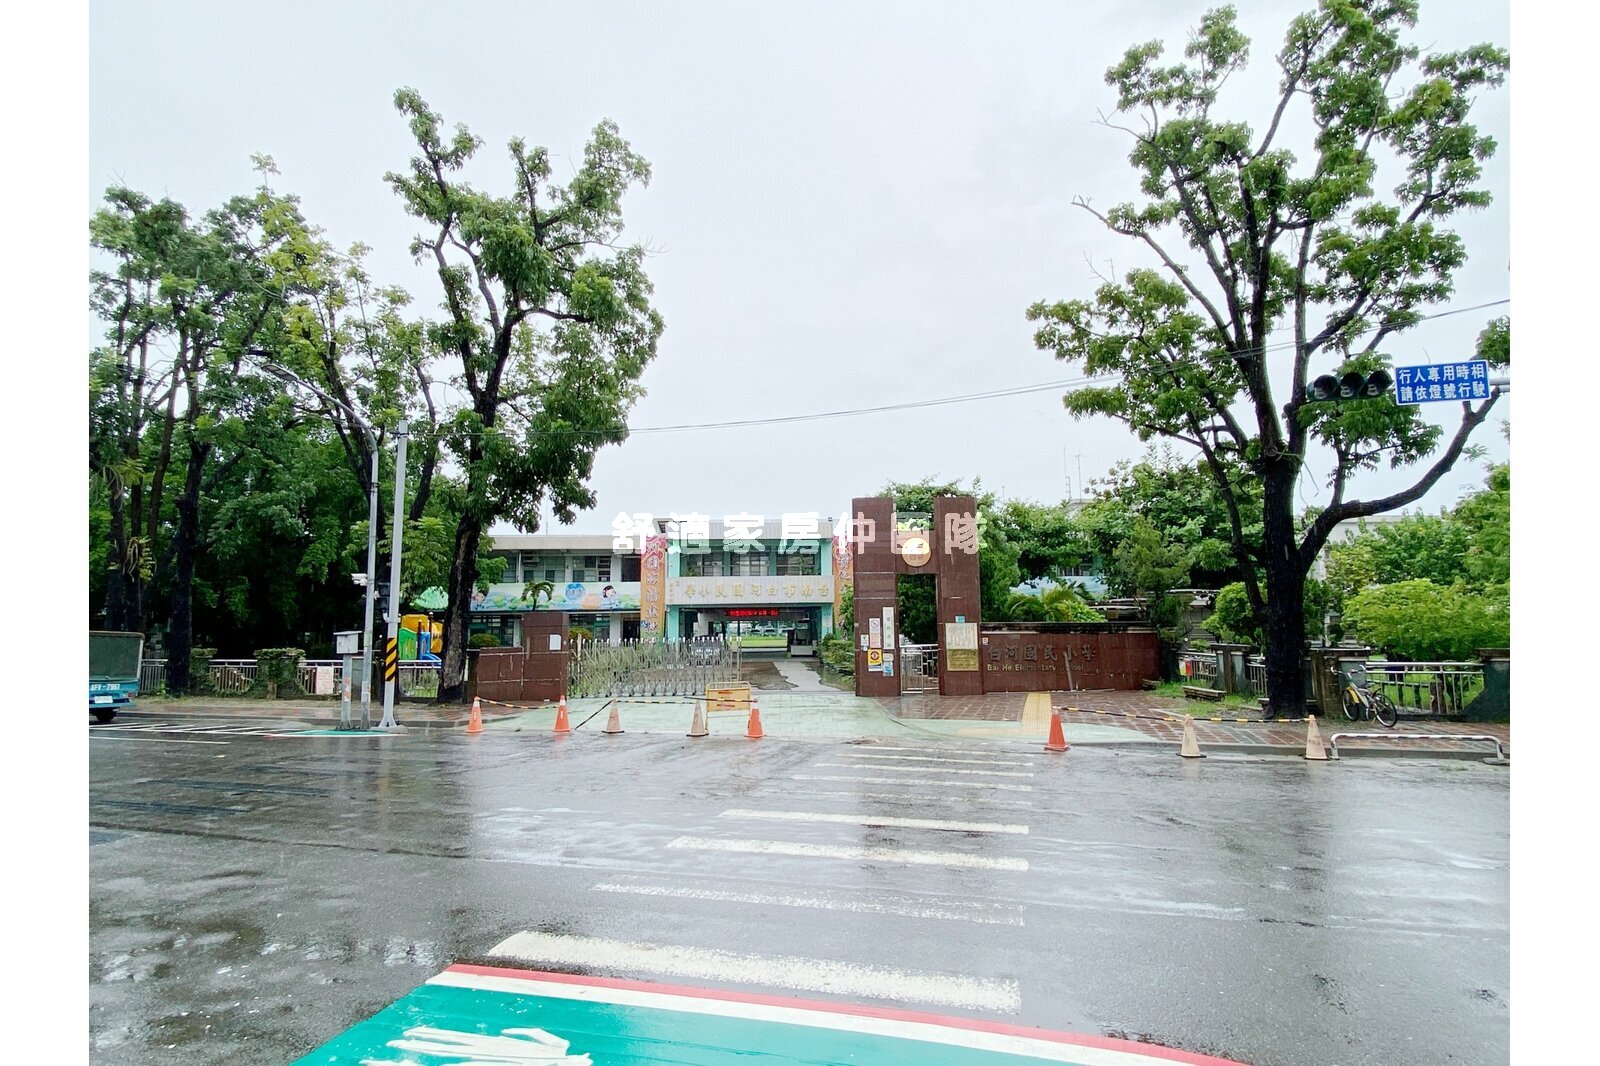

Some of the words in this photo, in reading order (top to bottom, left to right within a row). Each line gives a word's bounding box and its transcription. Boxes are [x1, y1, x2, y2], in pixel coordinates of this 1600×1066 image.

[1399, 363, 1485, 385] 行人專用時相
[1399, 380, 1488, 402] 請依燈號行駛
[987, 643, 1097, 662] 白河國民小學
[1002, 663, 1013, 672] He
[1014, 663, 1057, 674] Elemtary
